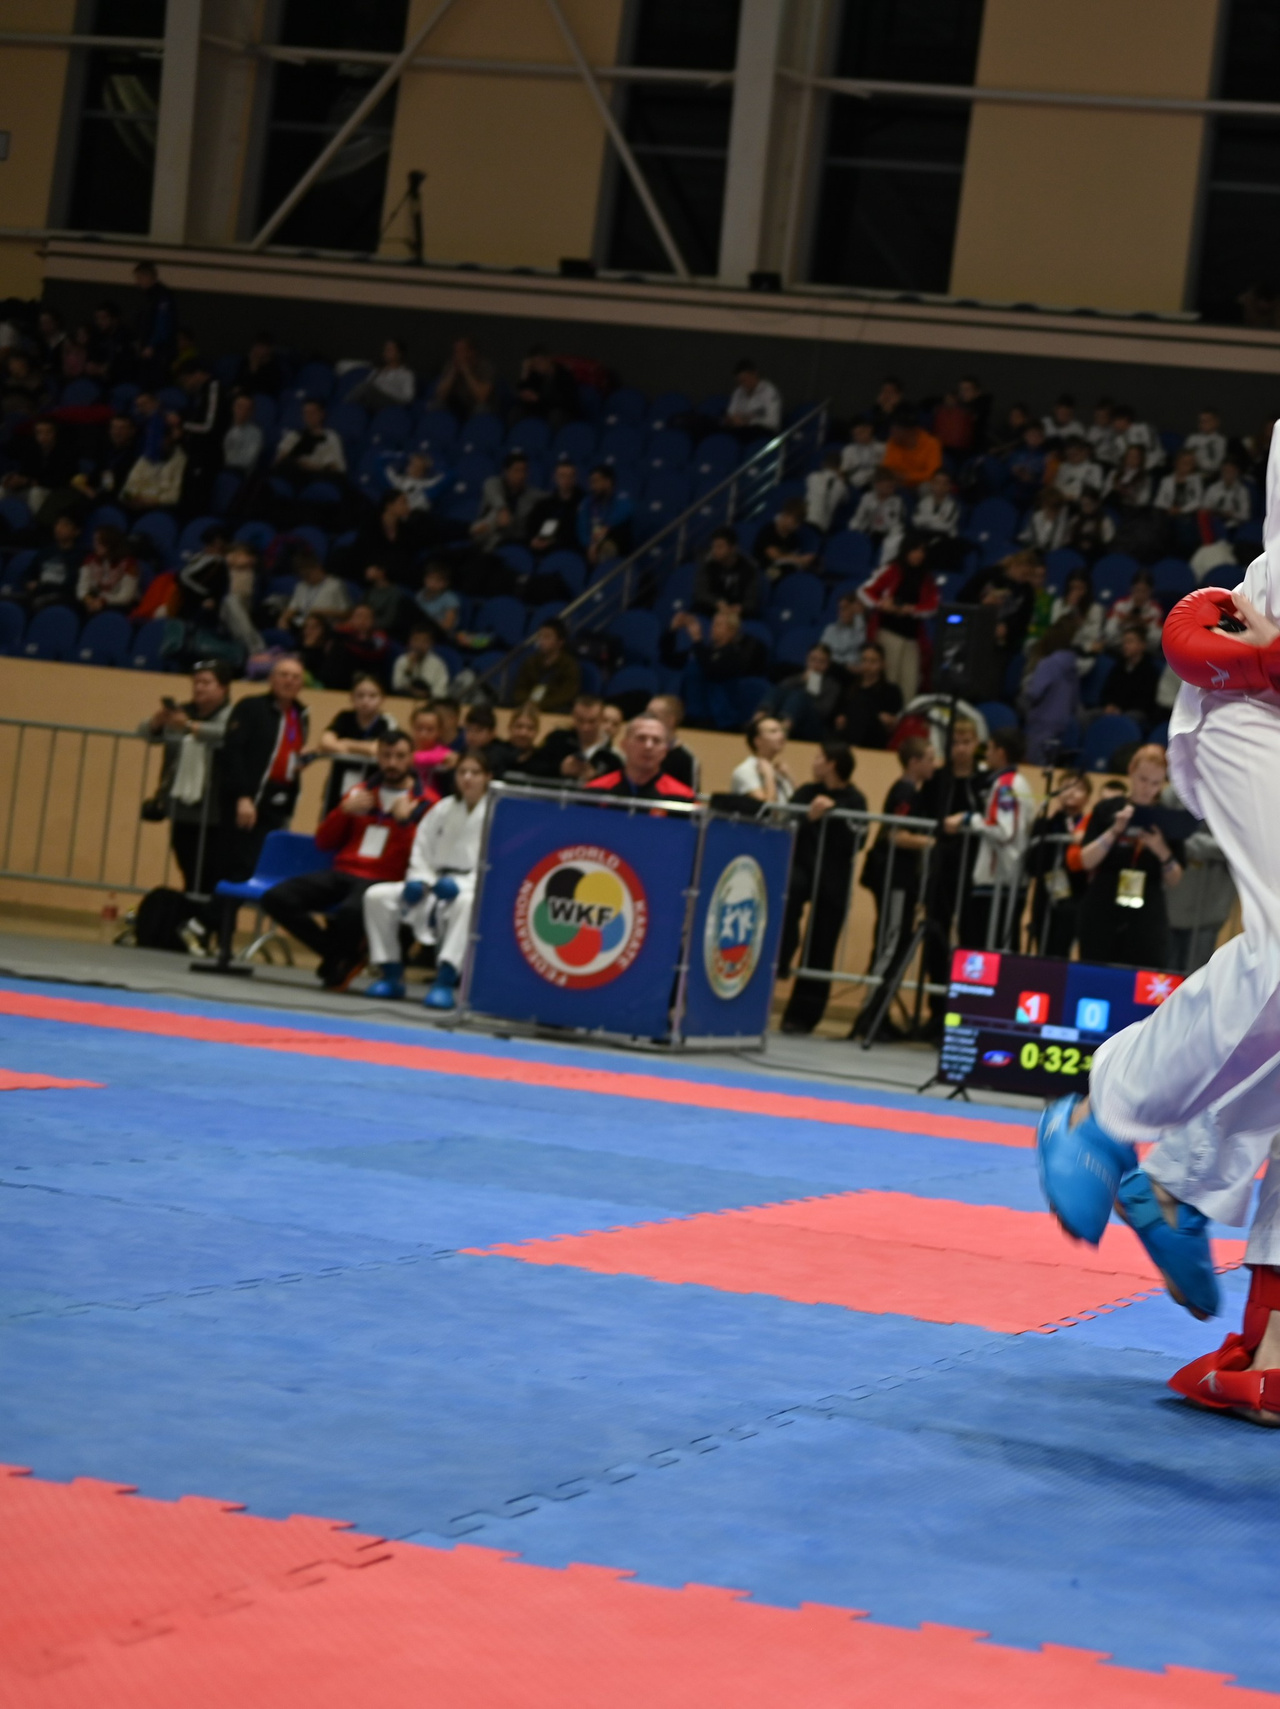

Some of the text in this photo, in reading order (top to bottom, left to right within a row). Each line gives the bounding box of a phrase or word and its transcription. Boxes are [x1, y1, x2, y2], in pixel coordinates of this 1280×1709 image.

[549, 899, 612, 927] WKF
[558, 848, 648, 969] WORLD KARATE
[515, 880, 568, 987] FEDERATION
[1025, 995, 1041, 1022] 1
[1085, 1003, 1101, 1026] 0
